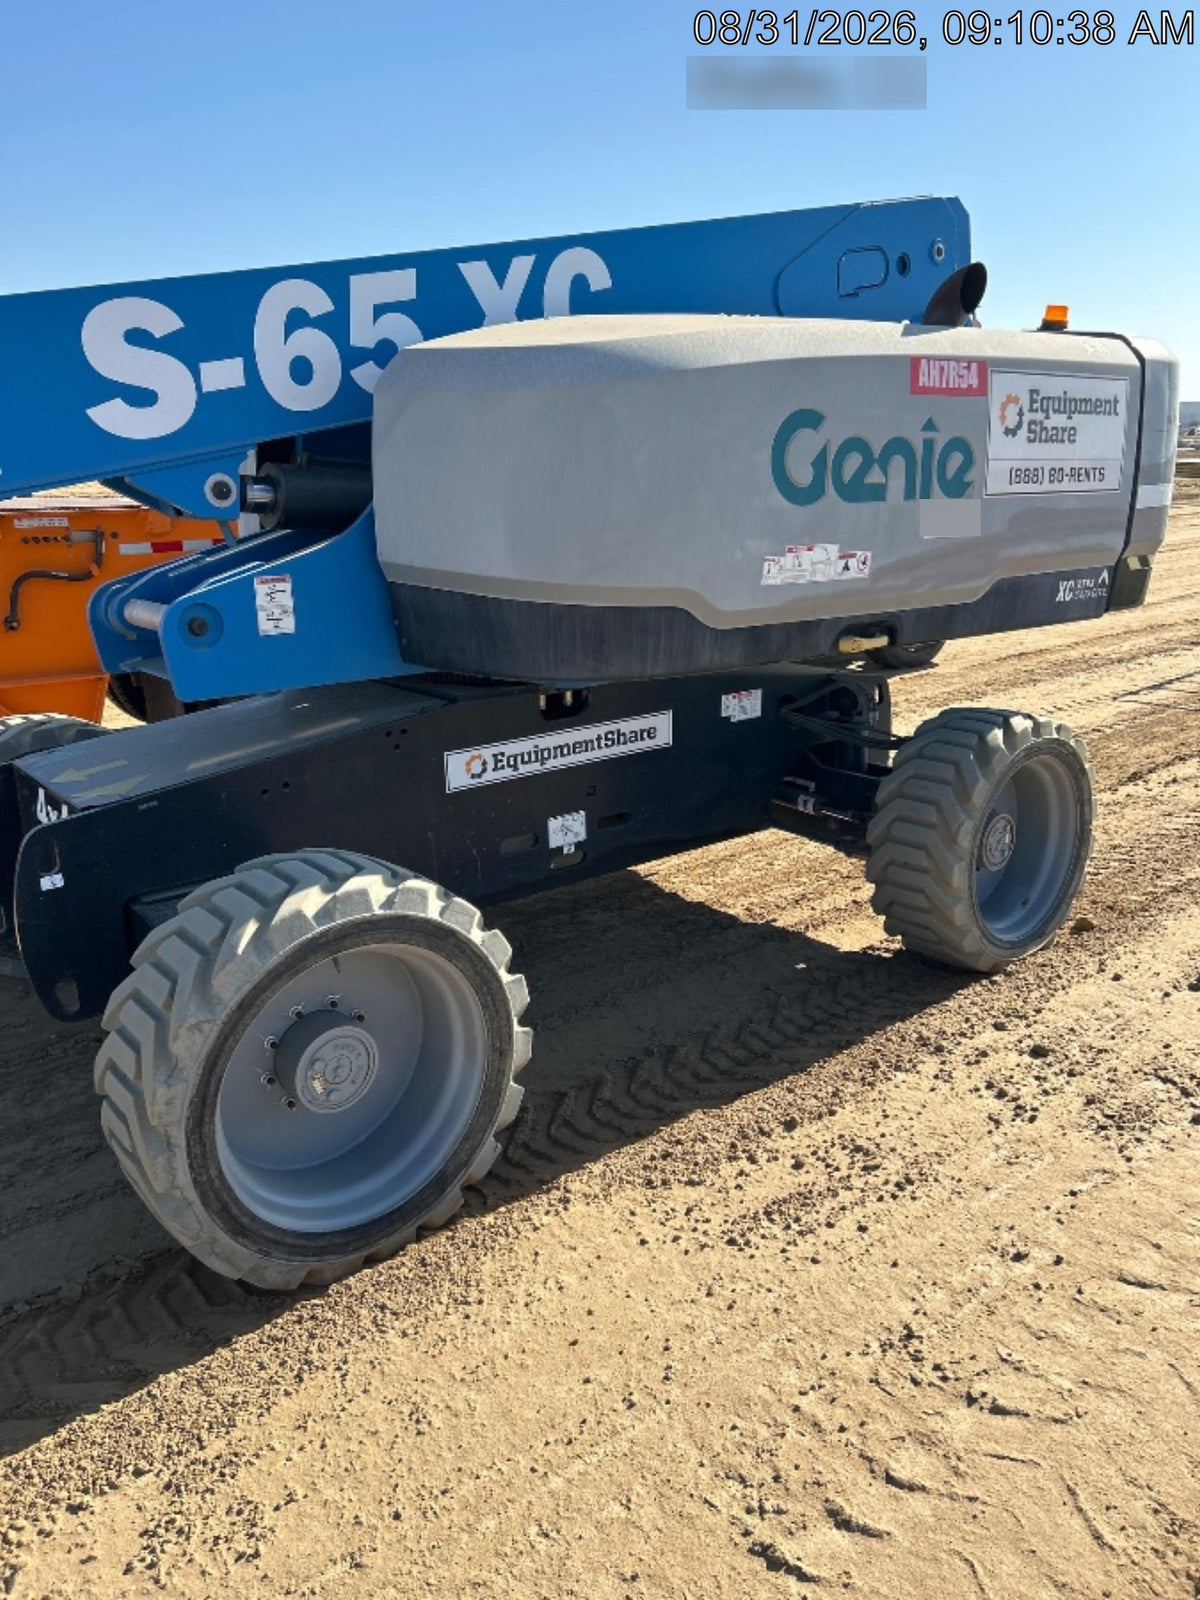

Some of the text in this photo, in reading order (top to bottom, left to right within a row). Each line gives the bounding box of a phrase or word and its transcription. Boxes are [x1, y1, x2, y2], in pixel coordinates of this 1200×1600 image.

[81, 267, 424, 440] S-65
[919, 358, 979, 389] AH7R54
[1027, 389, 1119, 419] Equipment
[1026, 419, 1077, 443] Share
[771, 408, 974, 507] Genie
[1009, 466, 1045, 486] (888)
[491, 726, 657, 772] EquipmentShare
